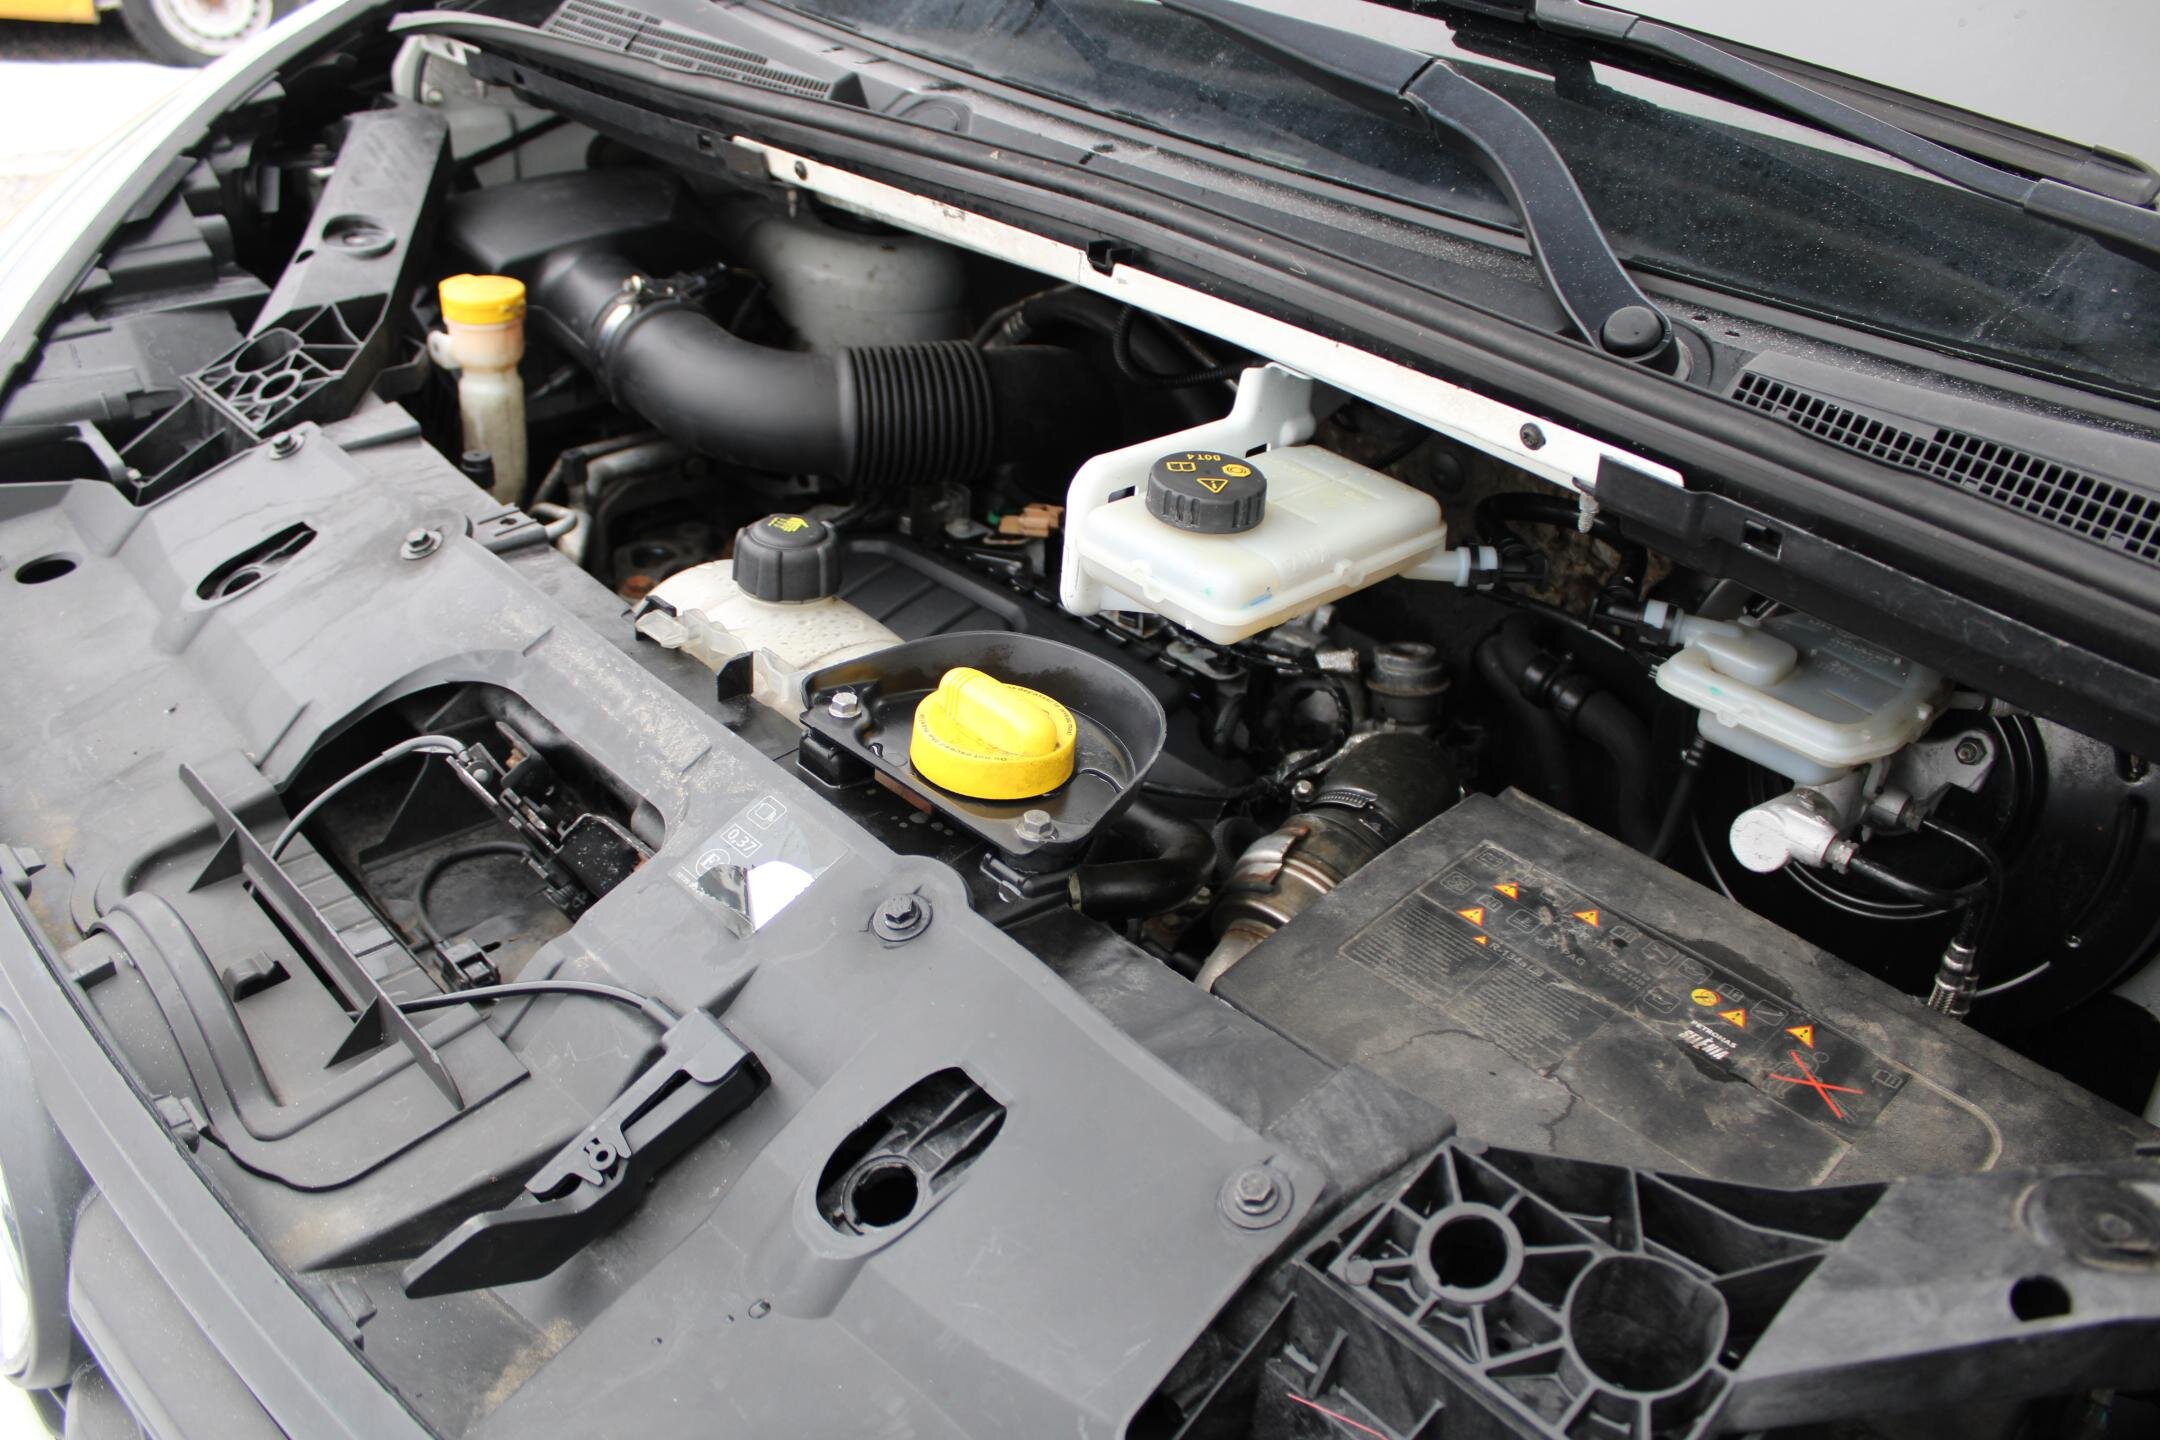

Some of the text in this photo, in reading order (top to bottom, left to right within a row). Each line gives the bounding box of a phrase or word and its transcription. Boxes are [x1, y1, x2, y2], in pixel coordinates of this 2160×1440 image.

[1197, 454, 1222, 462] DOT
[726, 827, 755, 852] 0,37
[1489, 941, 1528, 968] R-134a
[1690, 1020, 1738, 1049] PETRONAS
